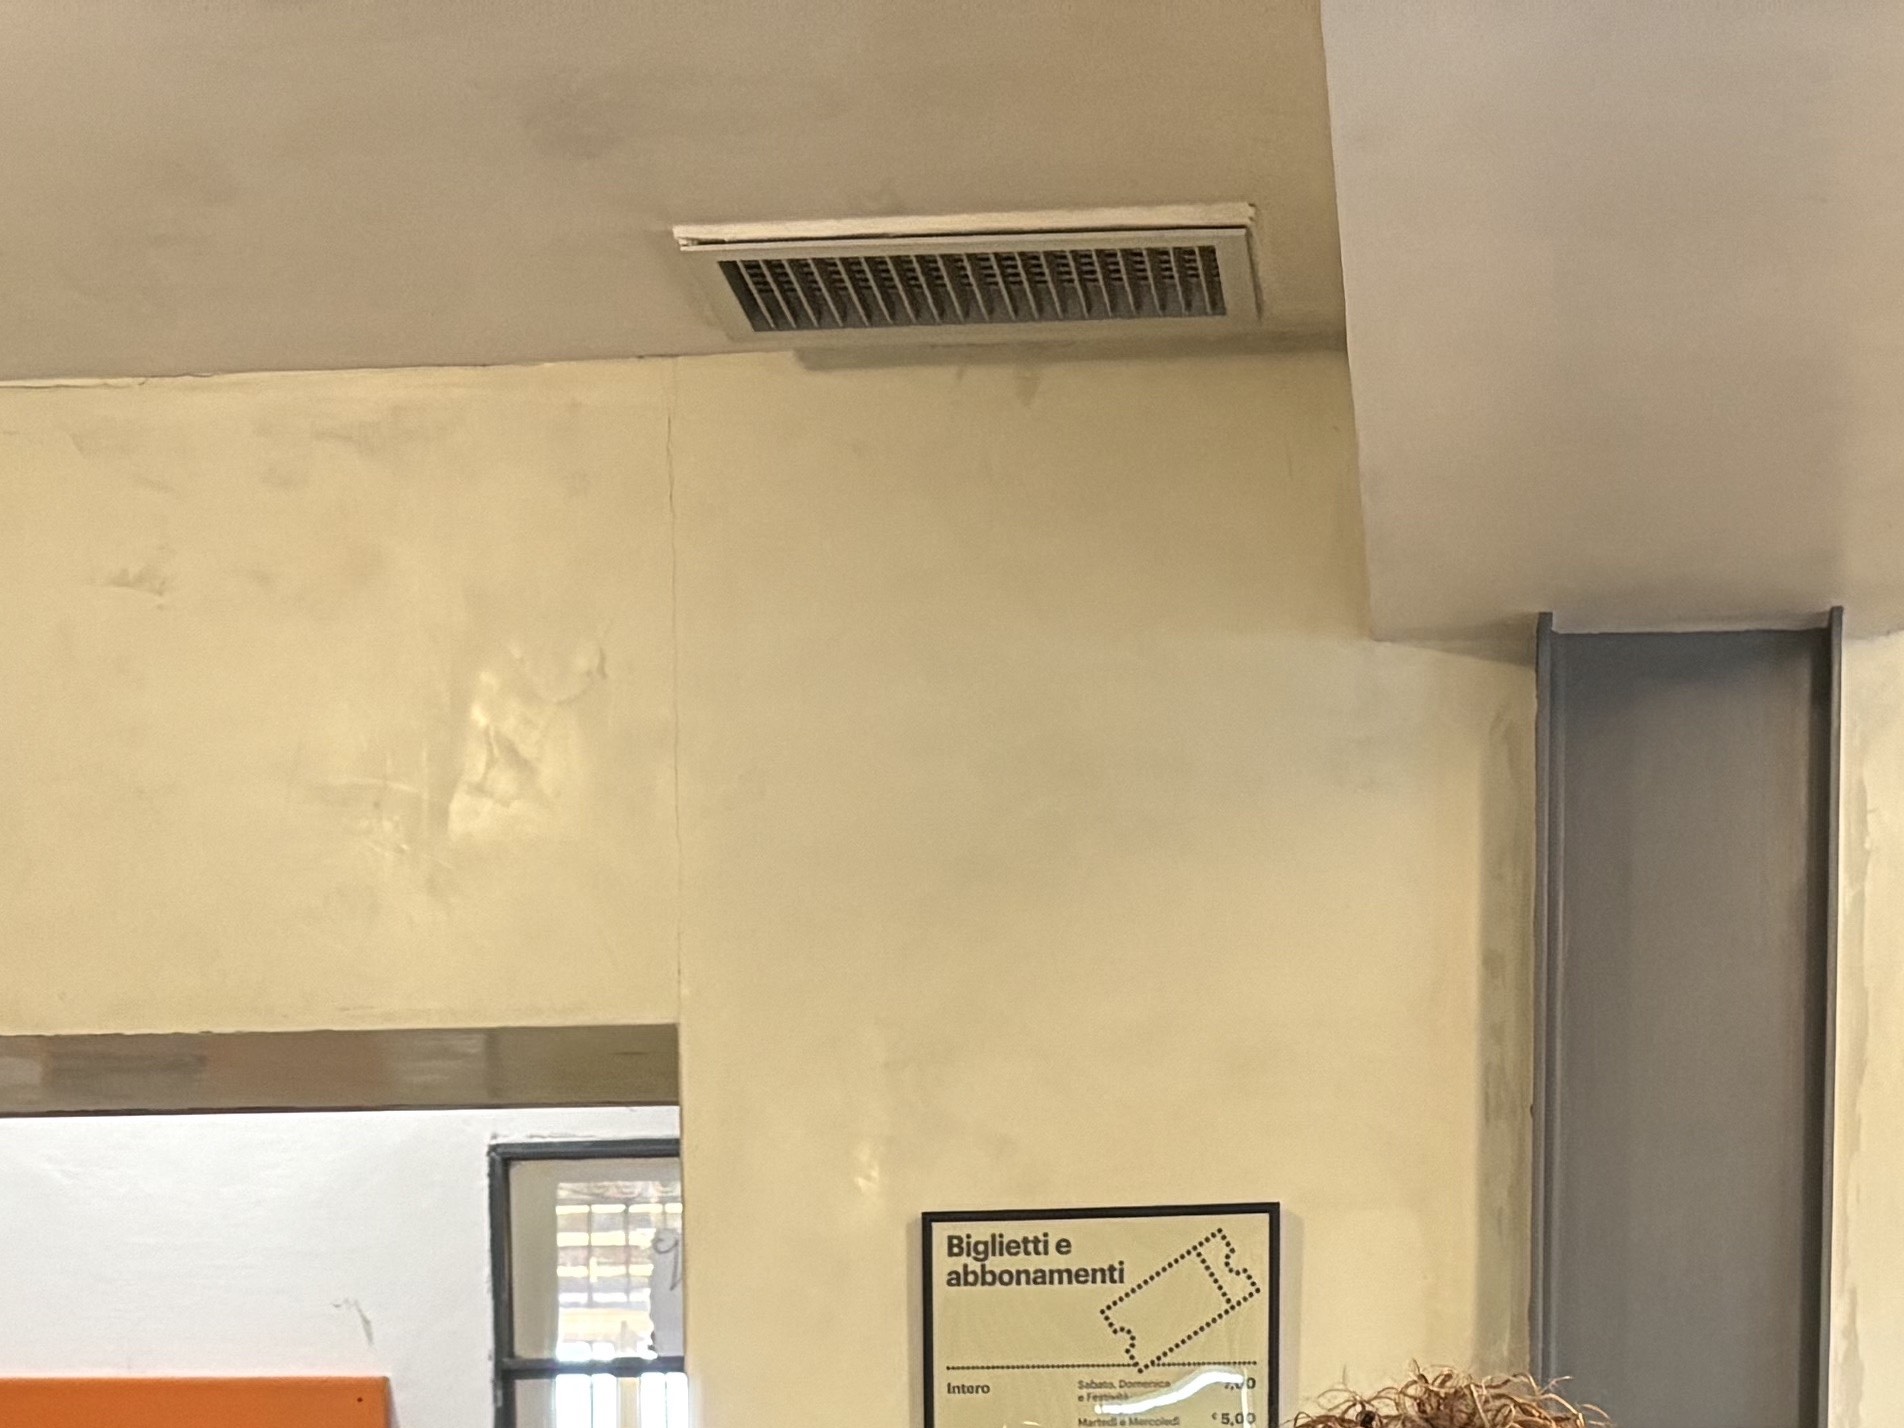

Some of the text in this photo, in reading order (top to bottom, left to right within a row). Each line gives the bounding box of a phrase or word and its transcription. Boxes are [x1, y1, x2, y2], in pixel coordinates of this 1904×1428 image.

[946, 1233, 1072, 1263] Biglietti e
[946, 1260, 1125, 1288] abbonamenti
[947, 1382, 990, 1395] Intero
[1221, 1412, 1256, 1427] 5,00
